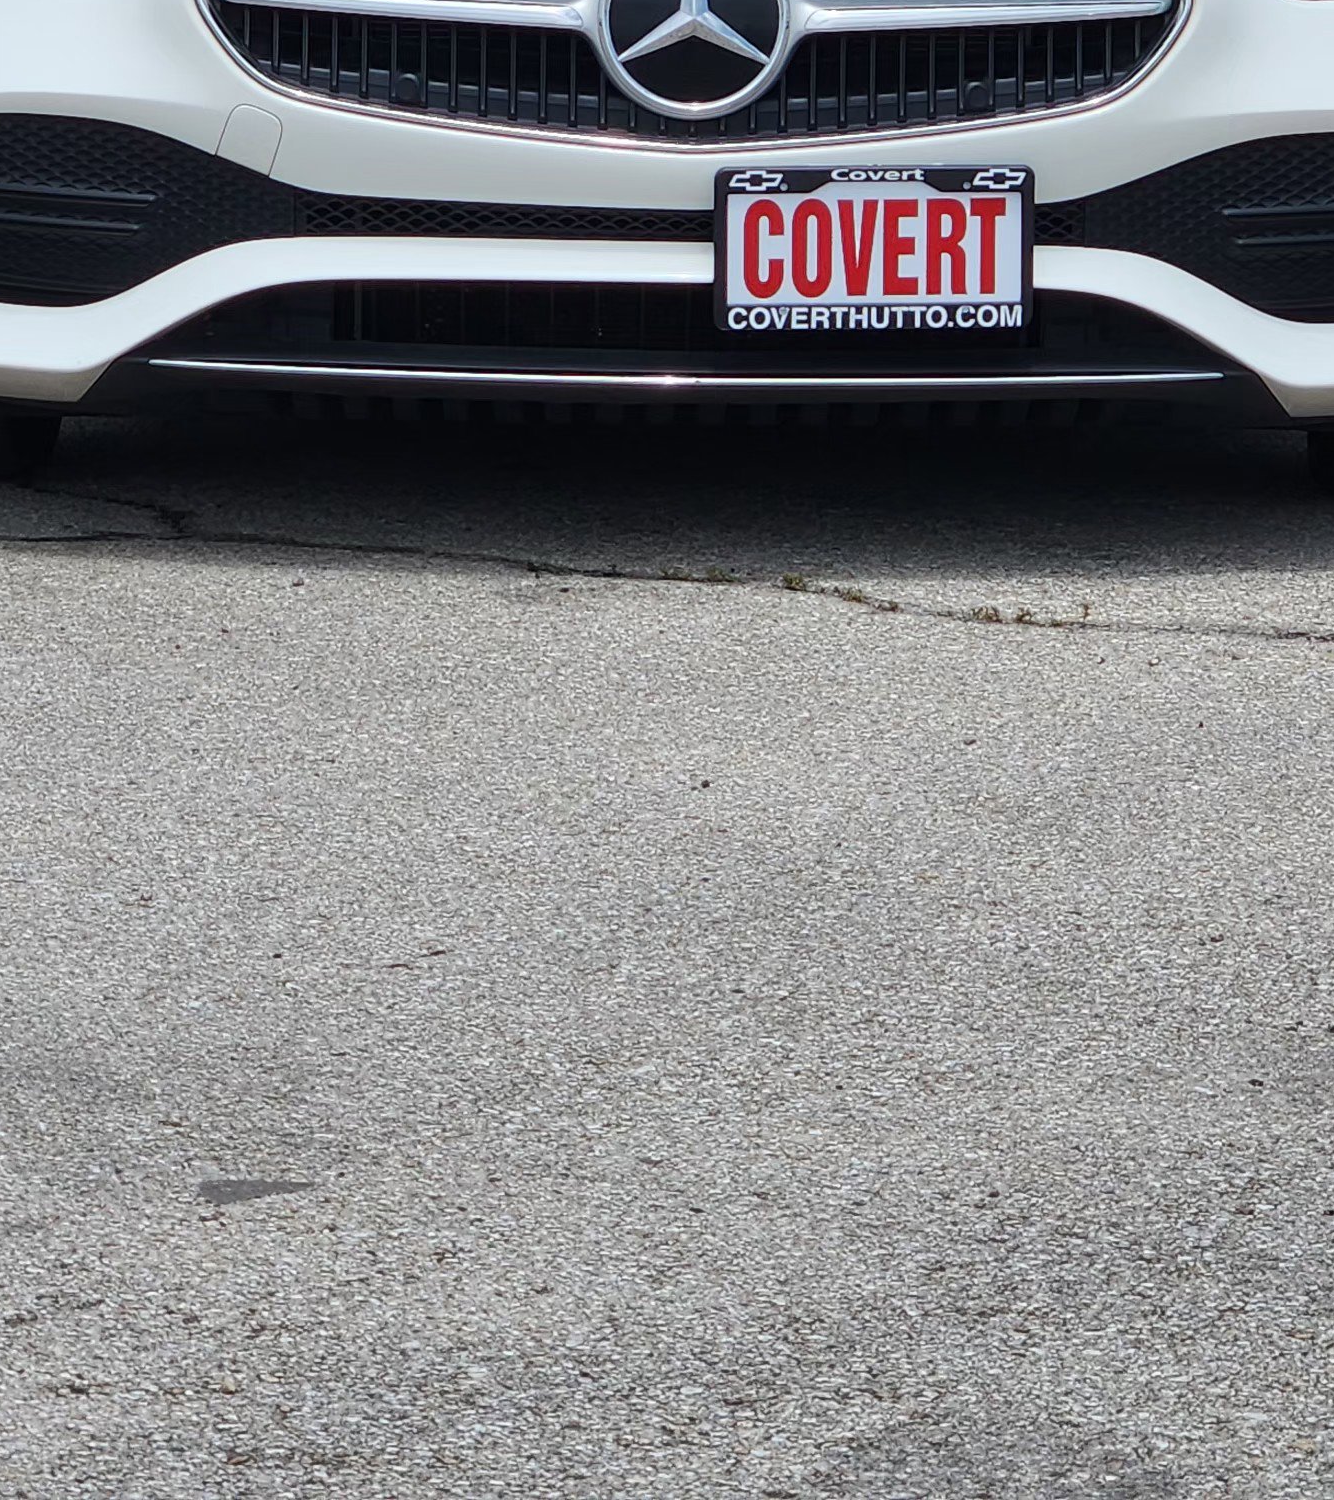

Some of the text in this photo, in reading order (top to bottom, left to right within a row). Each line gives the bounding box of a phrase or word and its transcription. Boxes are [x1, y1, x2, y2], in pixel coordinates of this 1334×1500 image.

[830, 167, 925, 182] Covert
[742, 197, 1007, 299] COVERT
[727, 304, 1023, 331] COVERTHUTTO.COM
